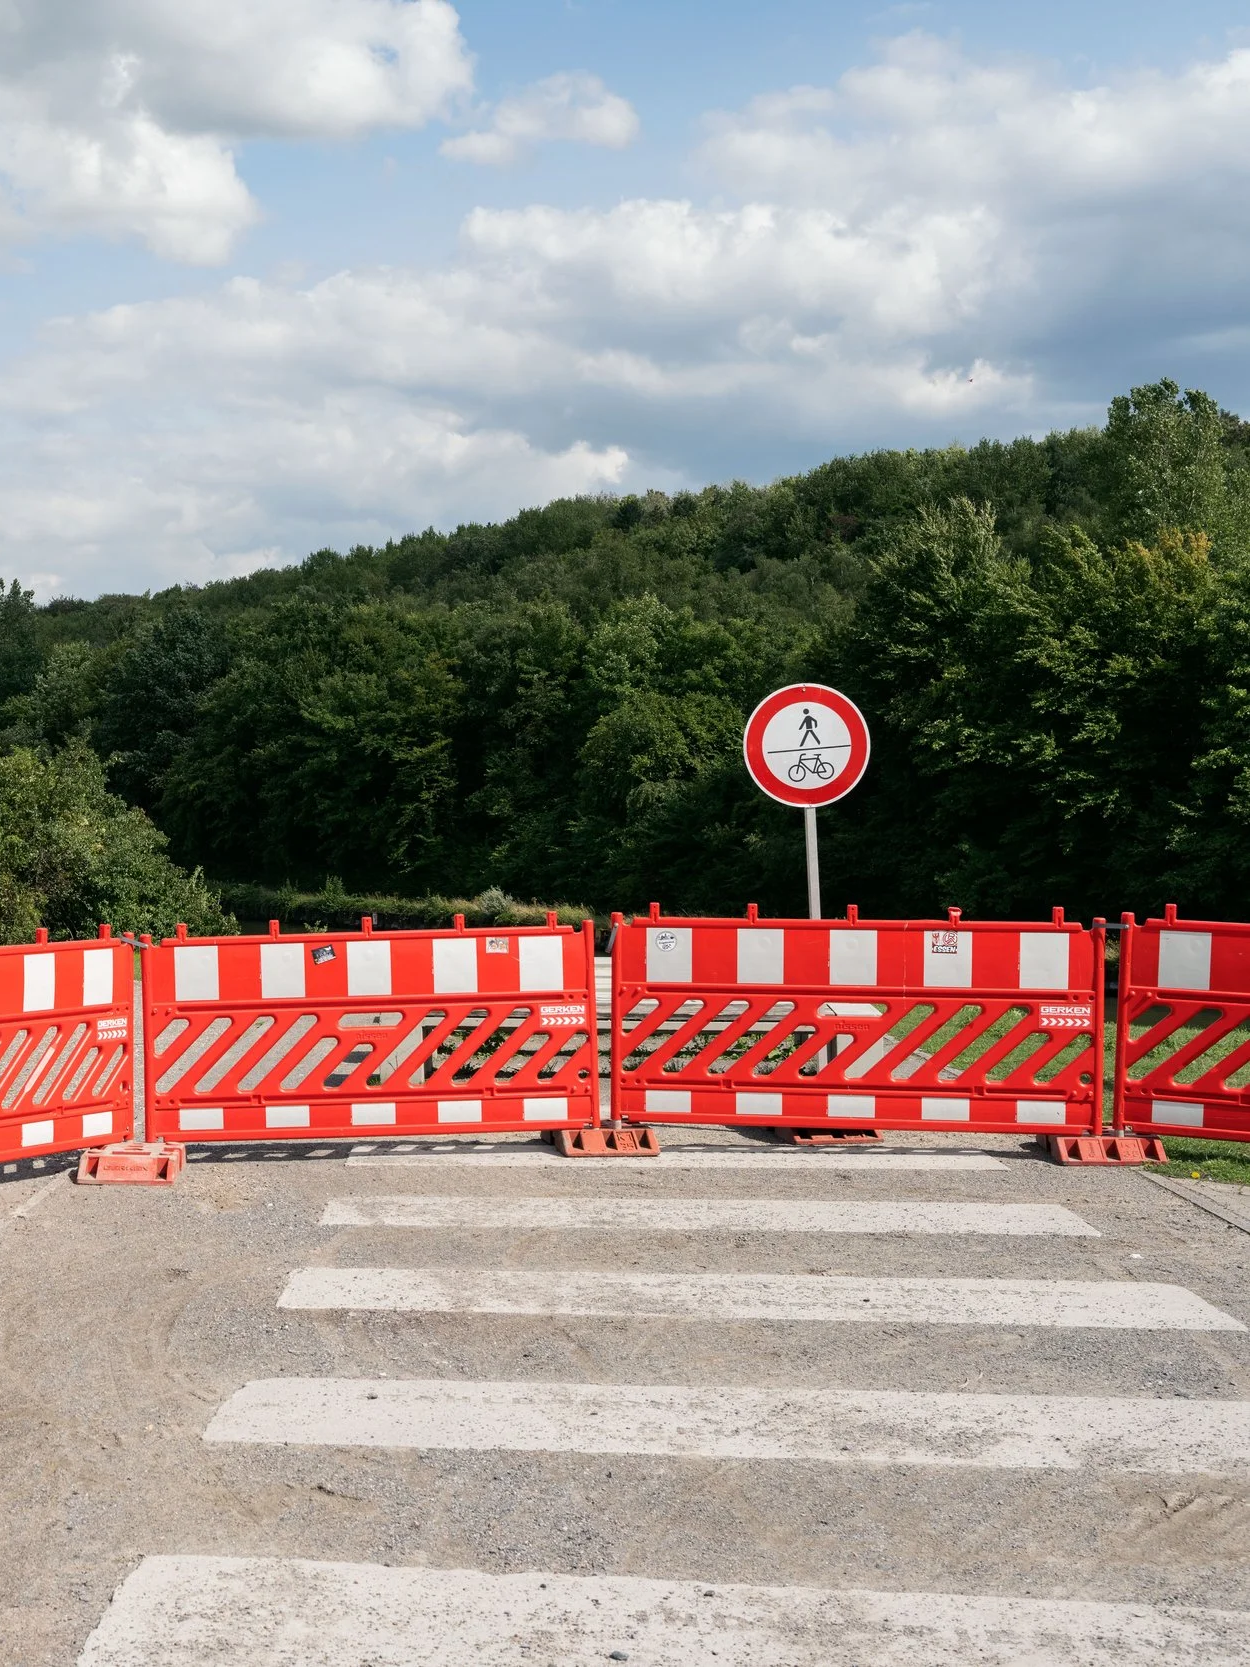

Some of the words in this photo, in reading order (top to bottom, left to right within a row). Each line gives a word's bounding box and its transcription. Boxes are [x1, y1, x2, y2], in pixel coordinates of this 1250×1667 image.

[933, 945, 956, 953] ESSEN
[540, 1005, 585, 1014] GERKEN
[1040, 1006, 1091, 1014] GERKEN
[98, 1018, 127, 1028] GERKEN
[834, 1020, 870, 1031] nissen
